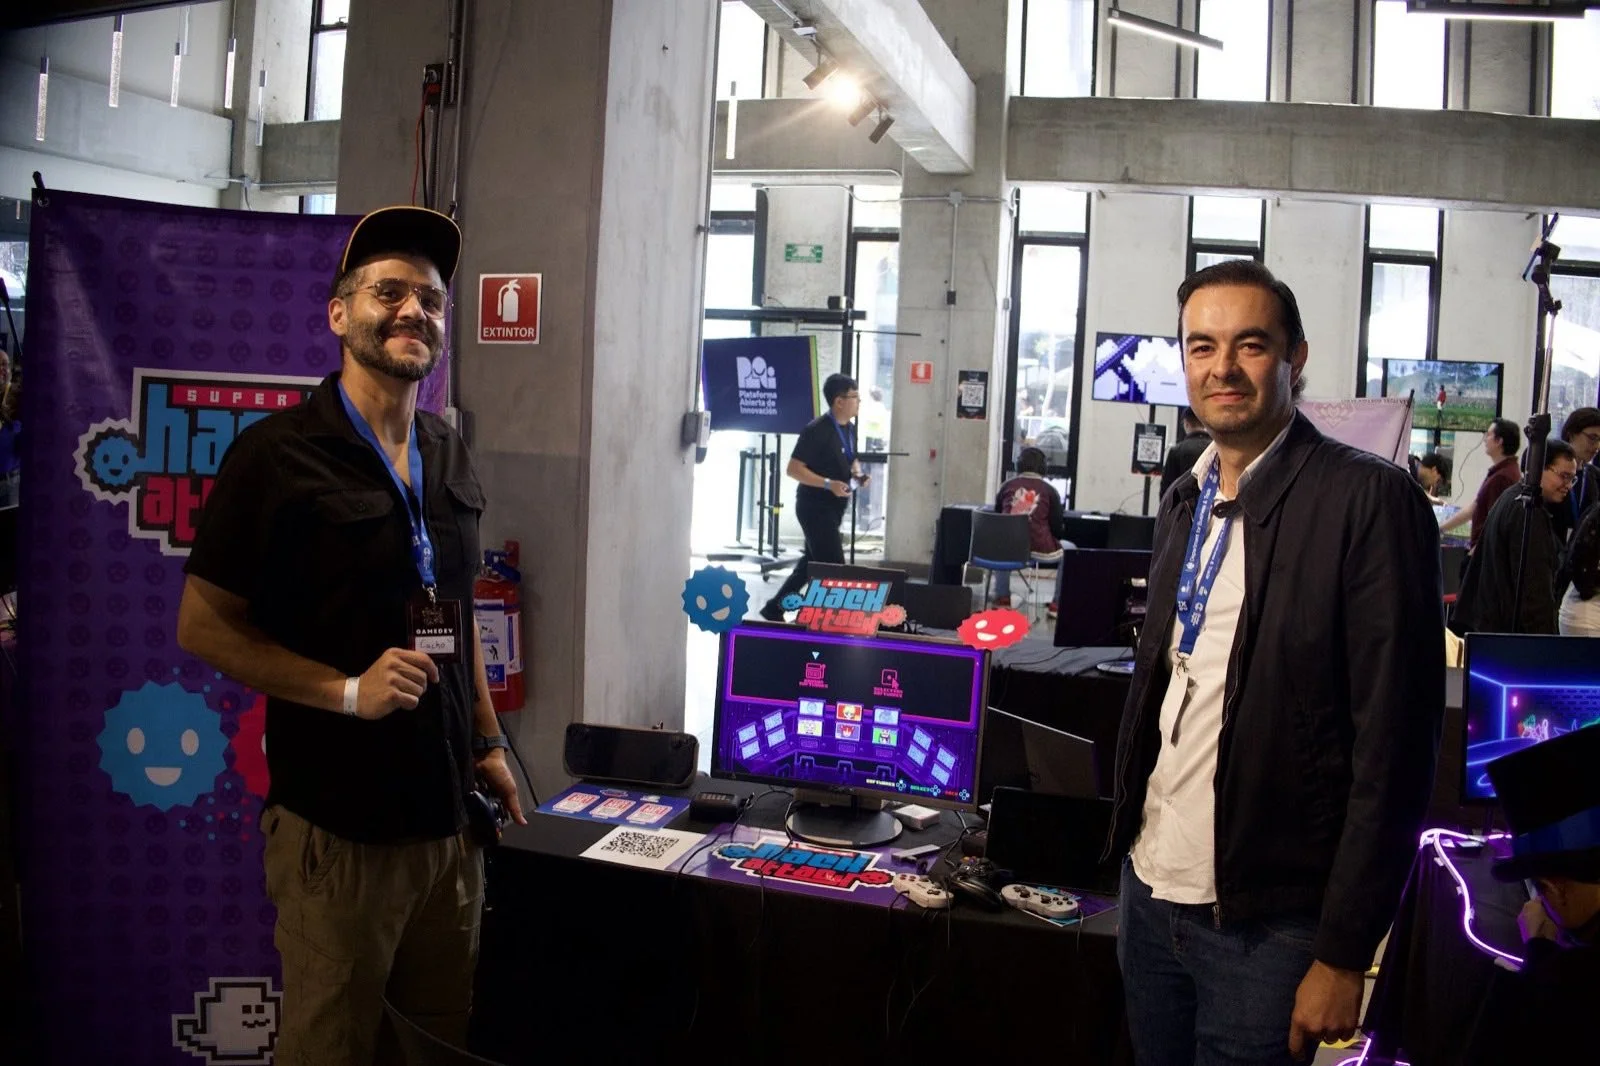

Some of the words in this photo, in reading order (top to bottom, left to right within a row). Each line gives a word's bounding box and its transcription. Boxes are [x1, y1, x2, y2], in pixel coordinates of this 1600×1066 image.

[483, 327, 535, 338] EXTINTOR
[187, 389, 287, 406] SUPER
[739, 390, 777, 399] Plataforma
[740, 398, 766, 407] Abierta
[766, 398, 776, 407] de
[740, 406, 777, 415] Innovación
